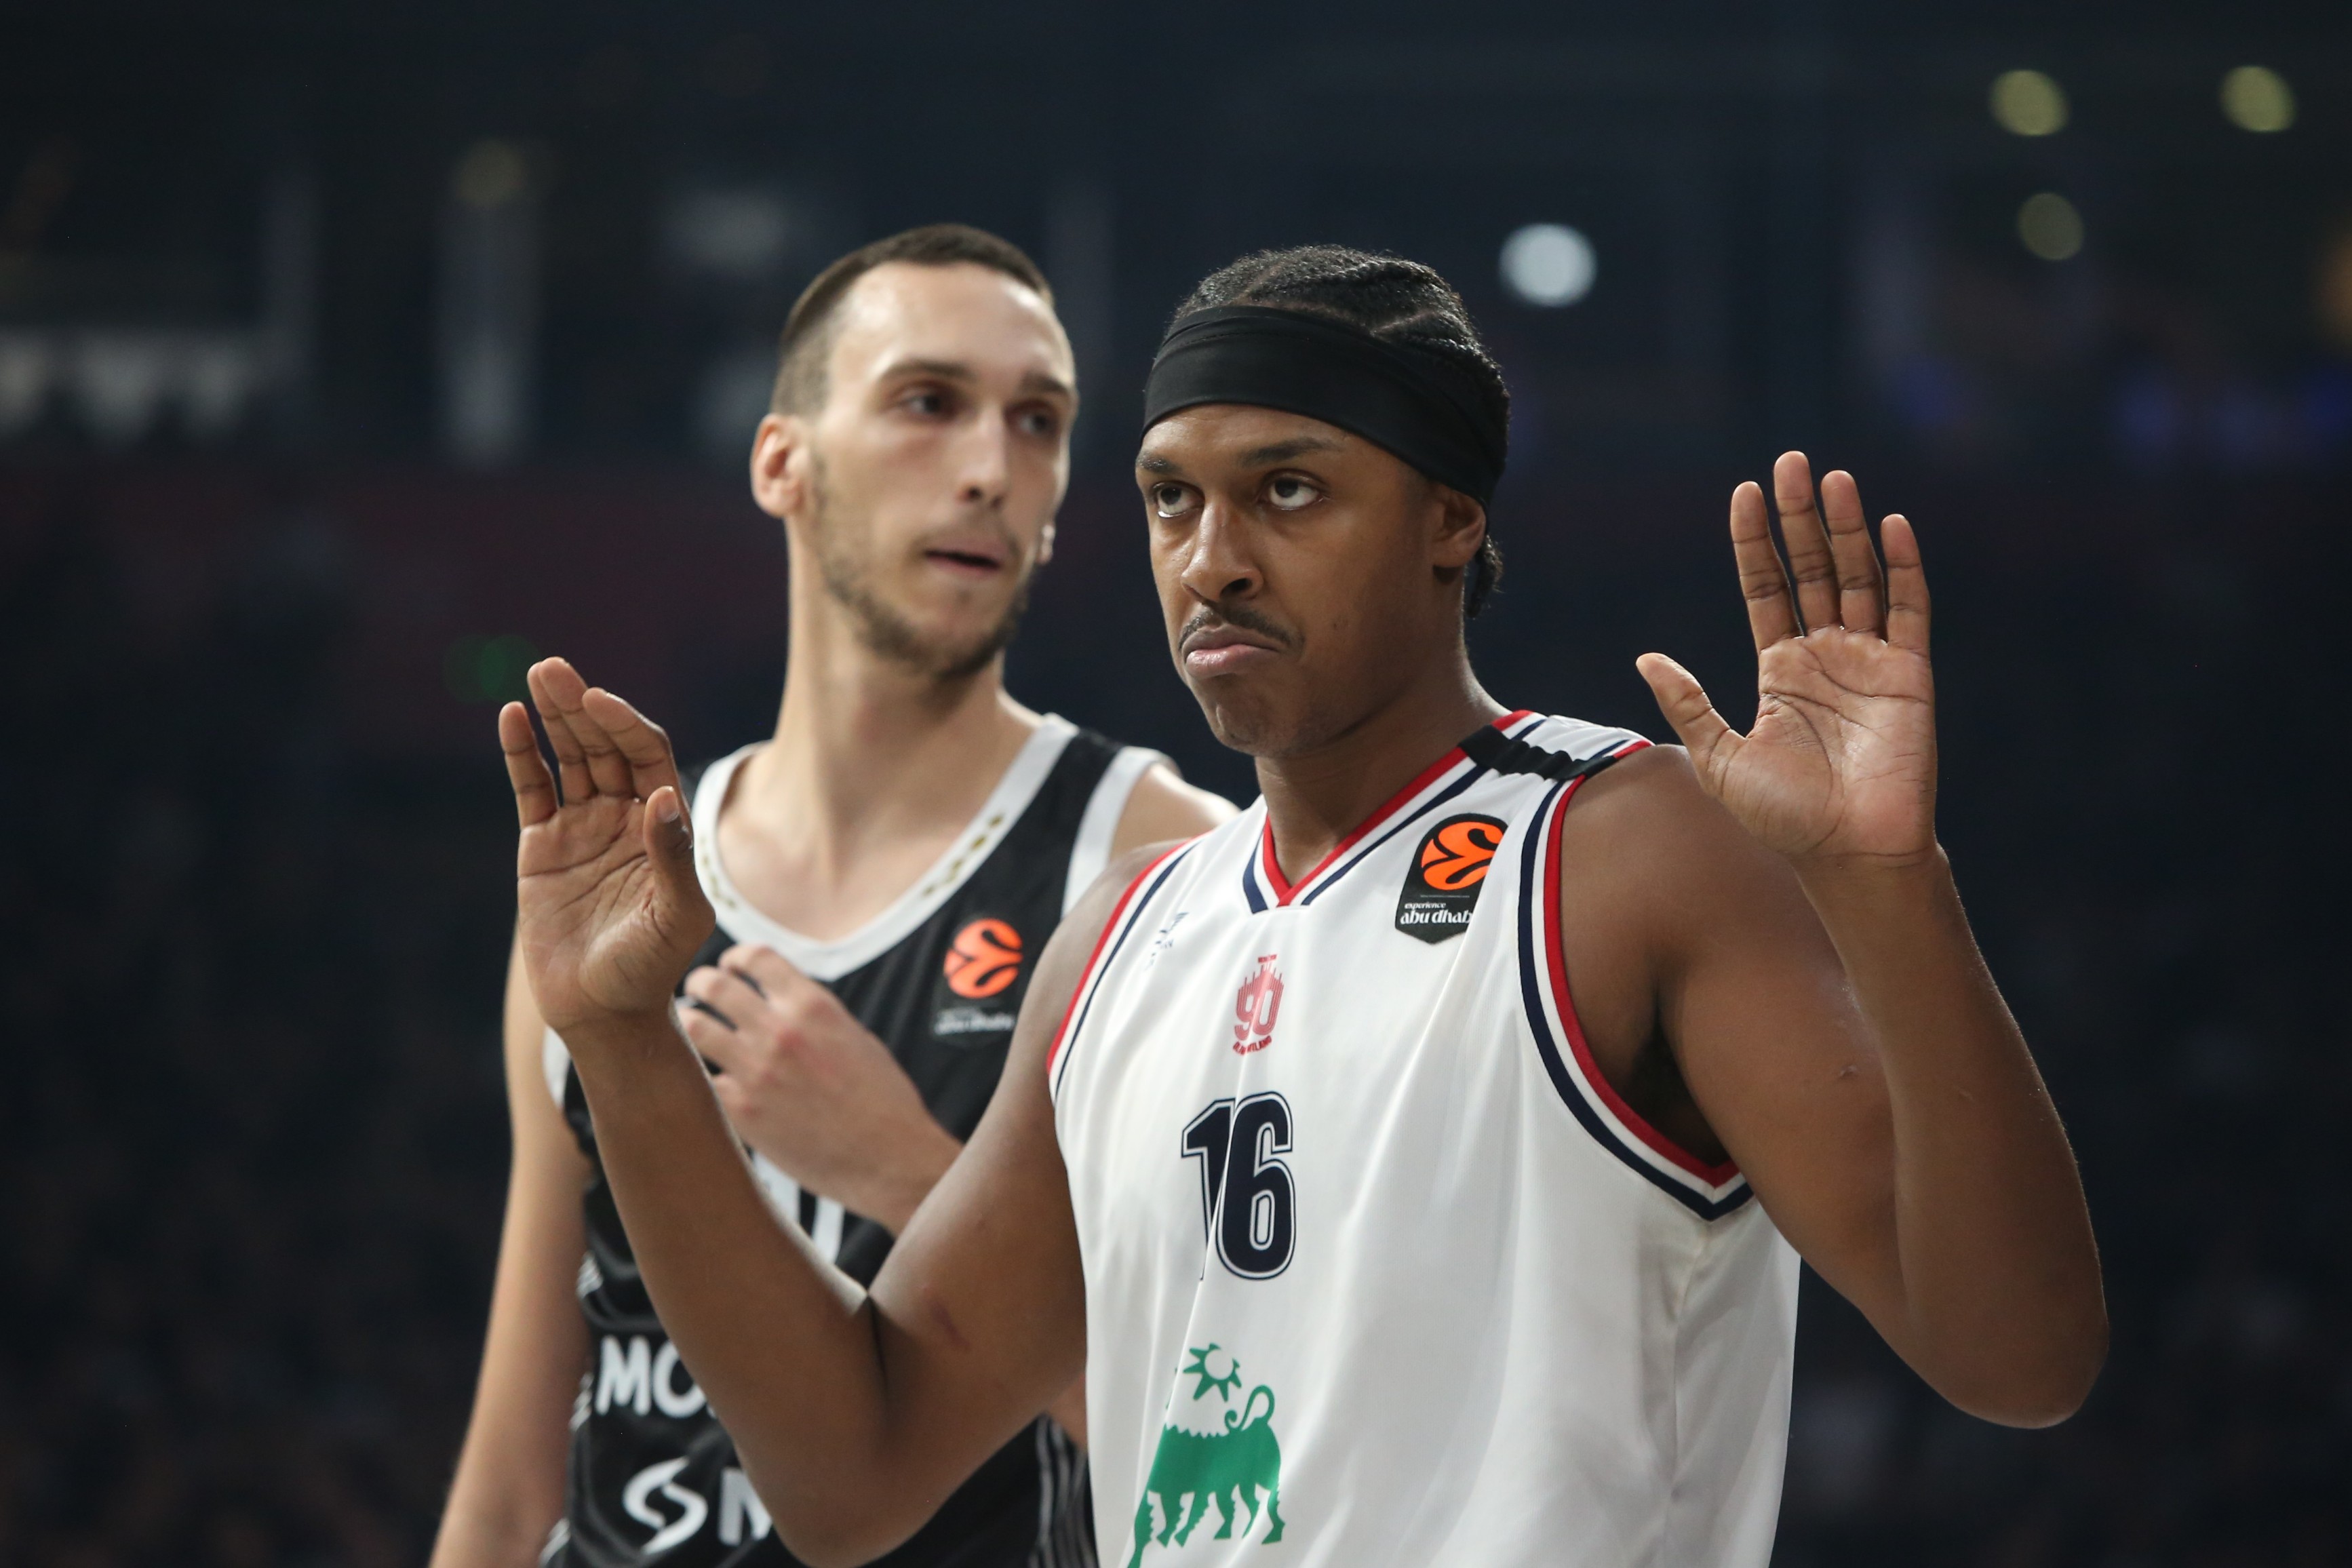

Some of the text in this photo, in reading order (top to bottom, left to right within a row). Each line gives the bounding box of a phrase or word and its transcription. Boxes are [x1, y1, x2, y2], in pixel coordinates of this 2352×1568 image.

[1400, 909, 1474, 924] abu dhab
[1404, 901, 1447, 910] experience
[1234, 968, 1285, 1040] 90
[1181, 1091, 1297, 1281] 16
[595, 1335, 716, 1419] MO
